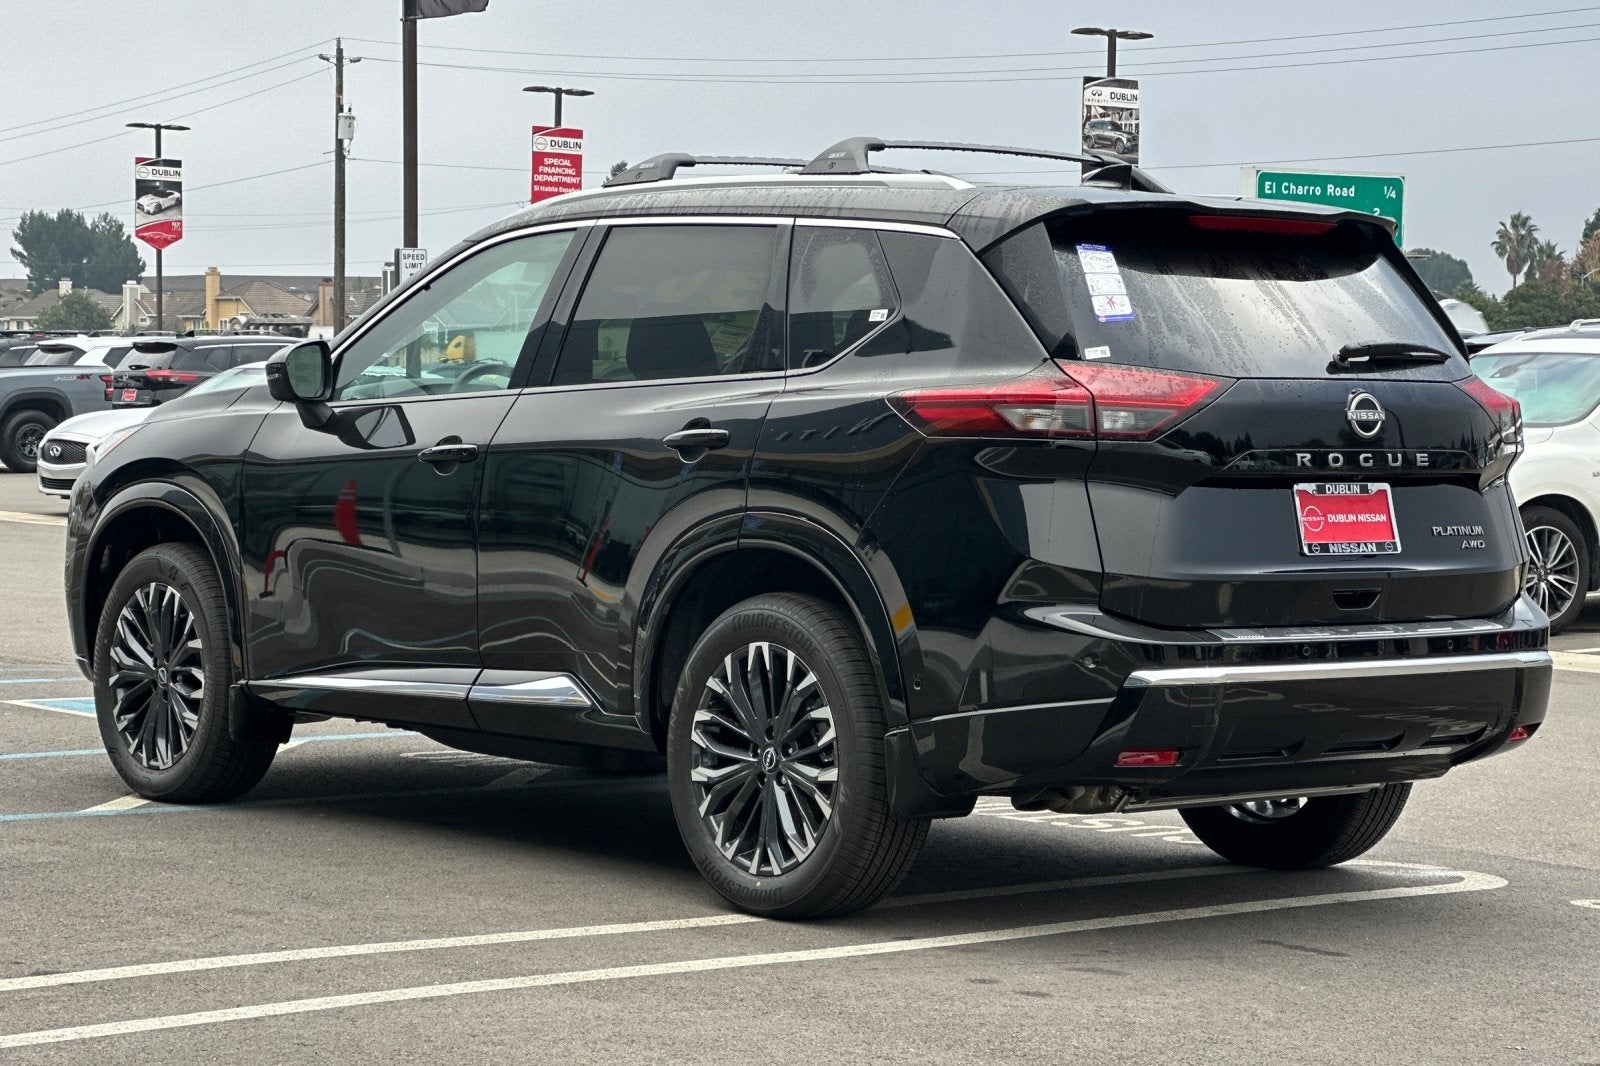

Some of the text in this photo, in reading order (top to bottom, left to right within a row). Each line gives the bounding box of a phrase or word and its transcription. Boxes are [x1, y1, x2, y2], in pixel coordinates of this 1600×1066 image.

[1110, 91, 1138, 102] DUBLIN
[550, 140, 581, 149] DUBLIN
[543, 158, 572, 166] SPECIAL
[151, 168, 181, 177] DUBLIN
[539, 166, 575, 175] FINANCING
[534, 175, 580, 184] DEPARTMENT
[1264, 181, 1397, 199] El Charro Road 1/4
[1349, 411, 1385, 420] NISSAN
[1295, 452, 1430, 468] ROGUE
[1325, 484, 1361, 494] DUBLIN
[1327, 513, 1387, 523] DUBLIN NISSAN
[1432, 525, 1485, 536] PLATINUM
[1328, 543, 1378, 553] NISSAN
[1461, 539, 1486, 549] AWD
